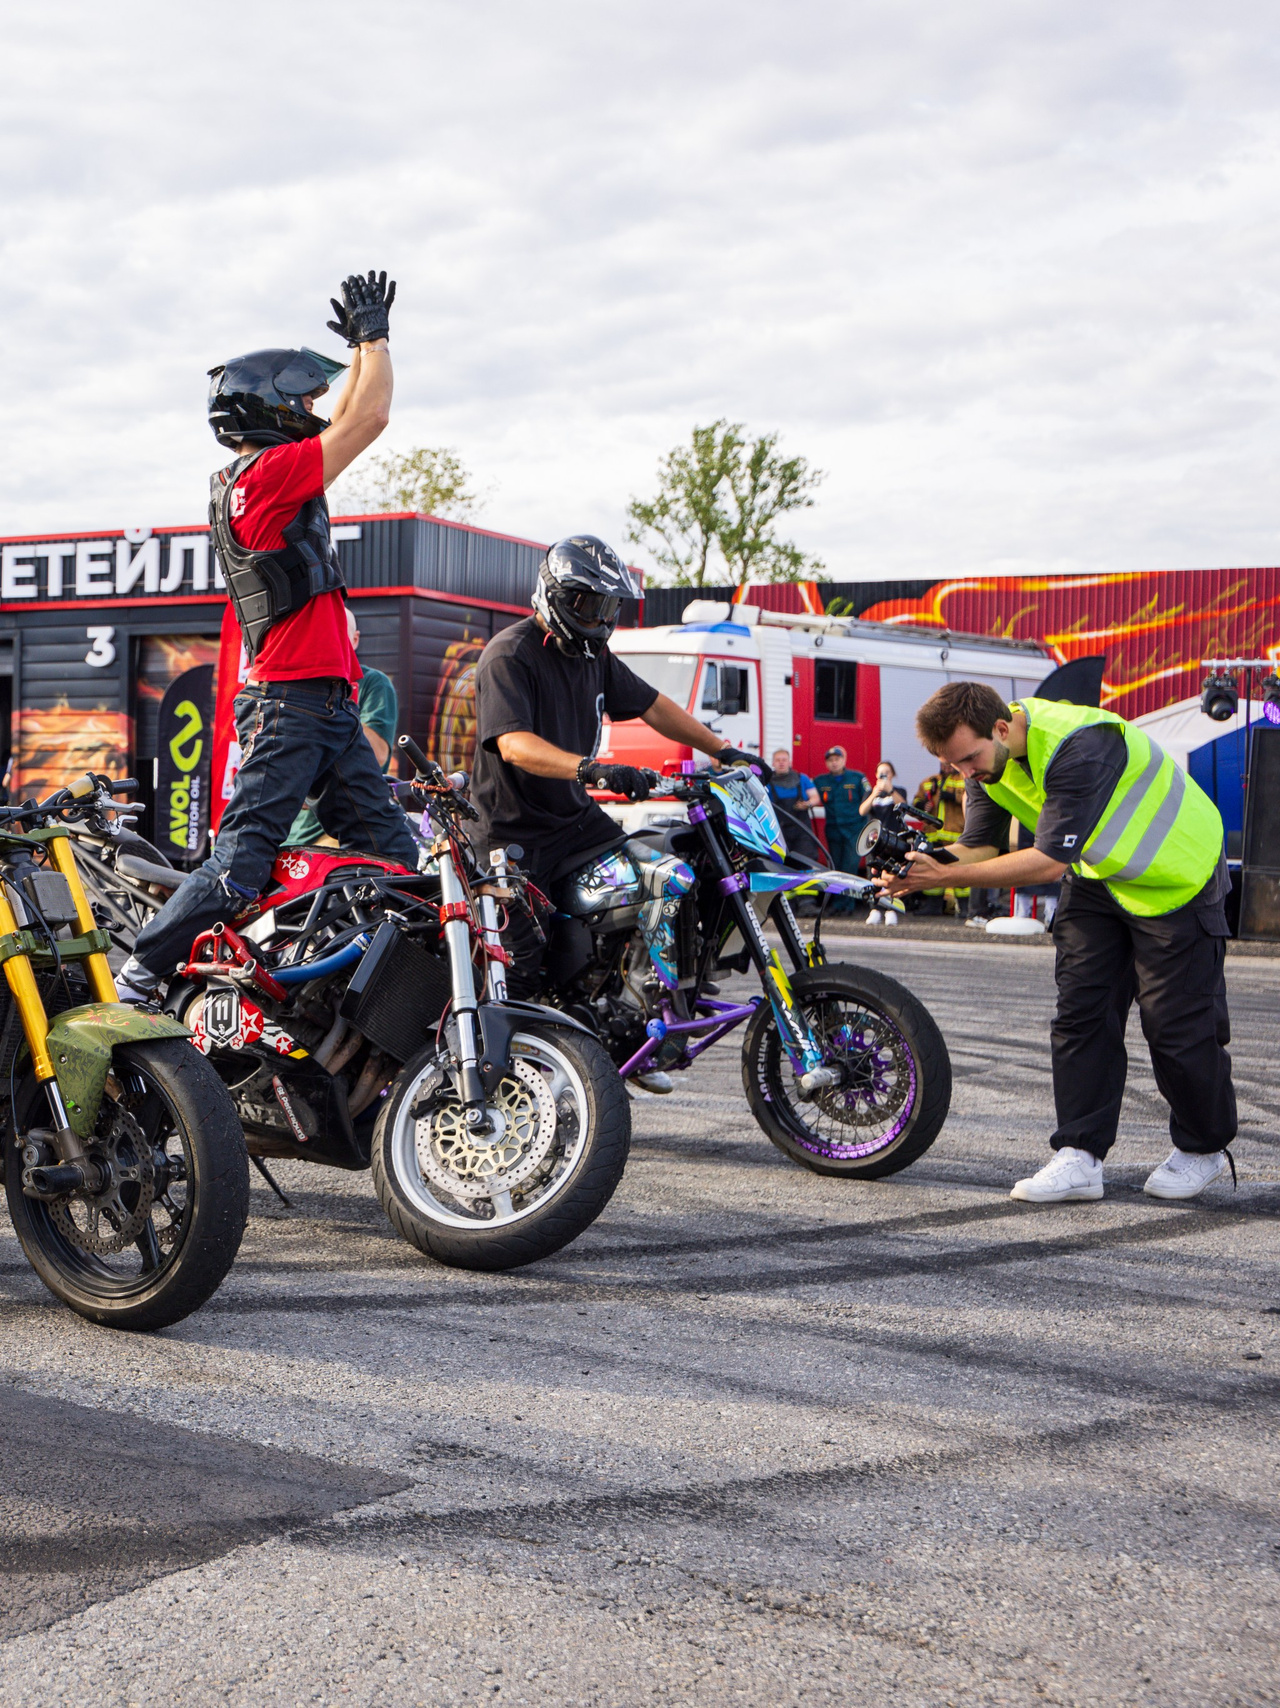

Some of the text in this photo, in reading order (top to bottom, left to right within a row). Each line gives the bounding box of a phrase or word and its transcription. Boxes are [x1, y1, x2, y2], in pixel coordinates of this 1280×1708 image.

[84, 626, 115, 668] 3
[170, 775, 191, 849] AVOL
[188, 776, 200, 850] MOTOR OIL
[215, 1000, 228, 1021] 11
